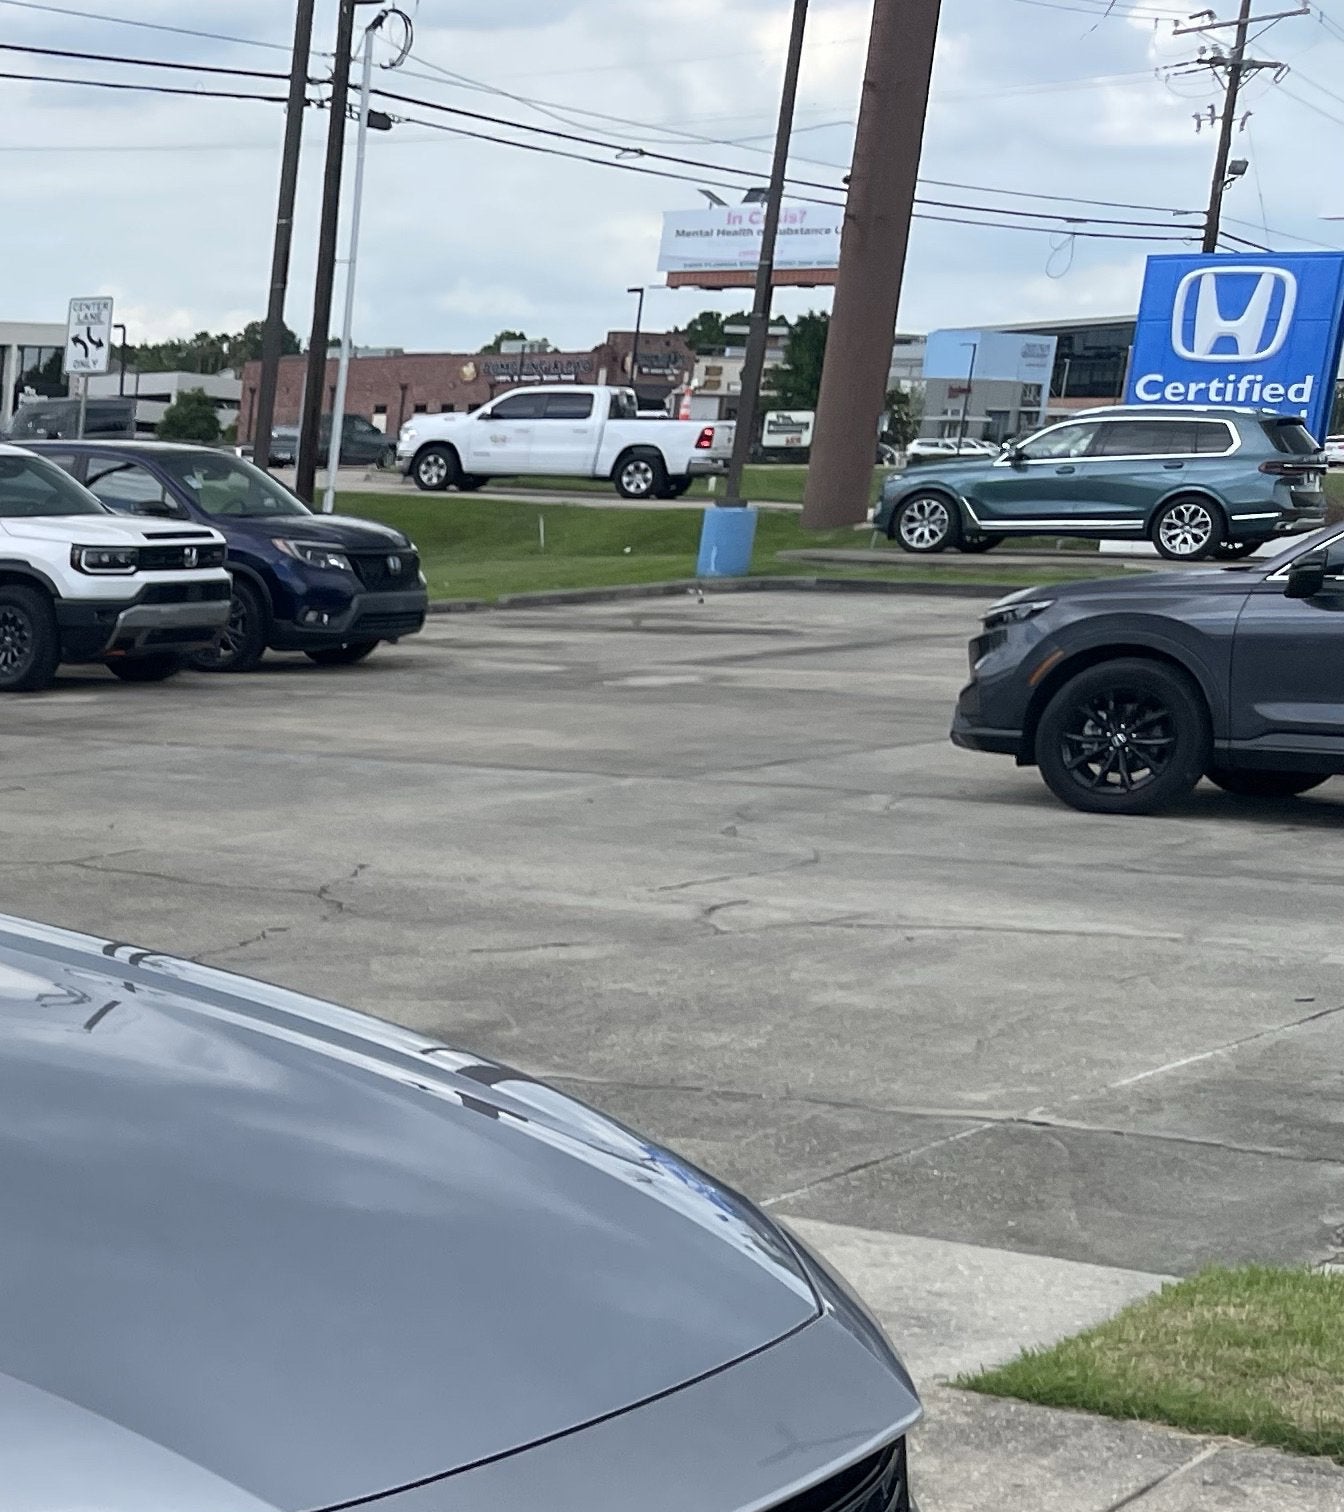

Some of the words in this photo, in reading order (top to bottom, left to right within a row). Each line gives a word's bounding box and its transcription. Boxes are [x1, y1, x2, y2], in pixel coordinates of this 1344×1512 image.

[674, 229, 713, 239] Mental
[716, 228, 754, 238] Health
[778, 227, 832, 237] ubstance
[1135, 373, 1314, 403] Certified
